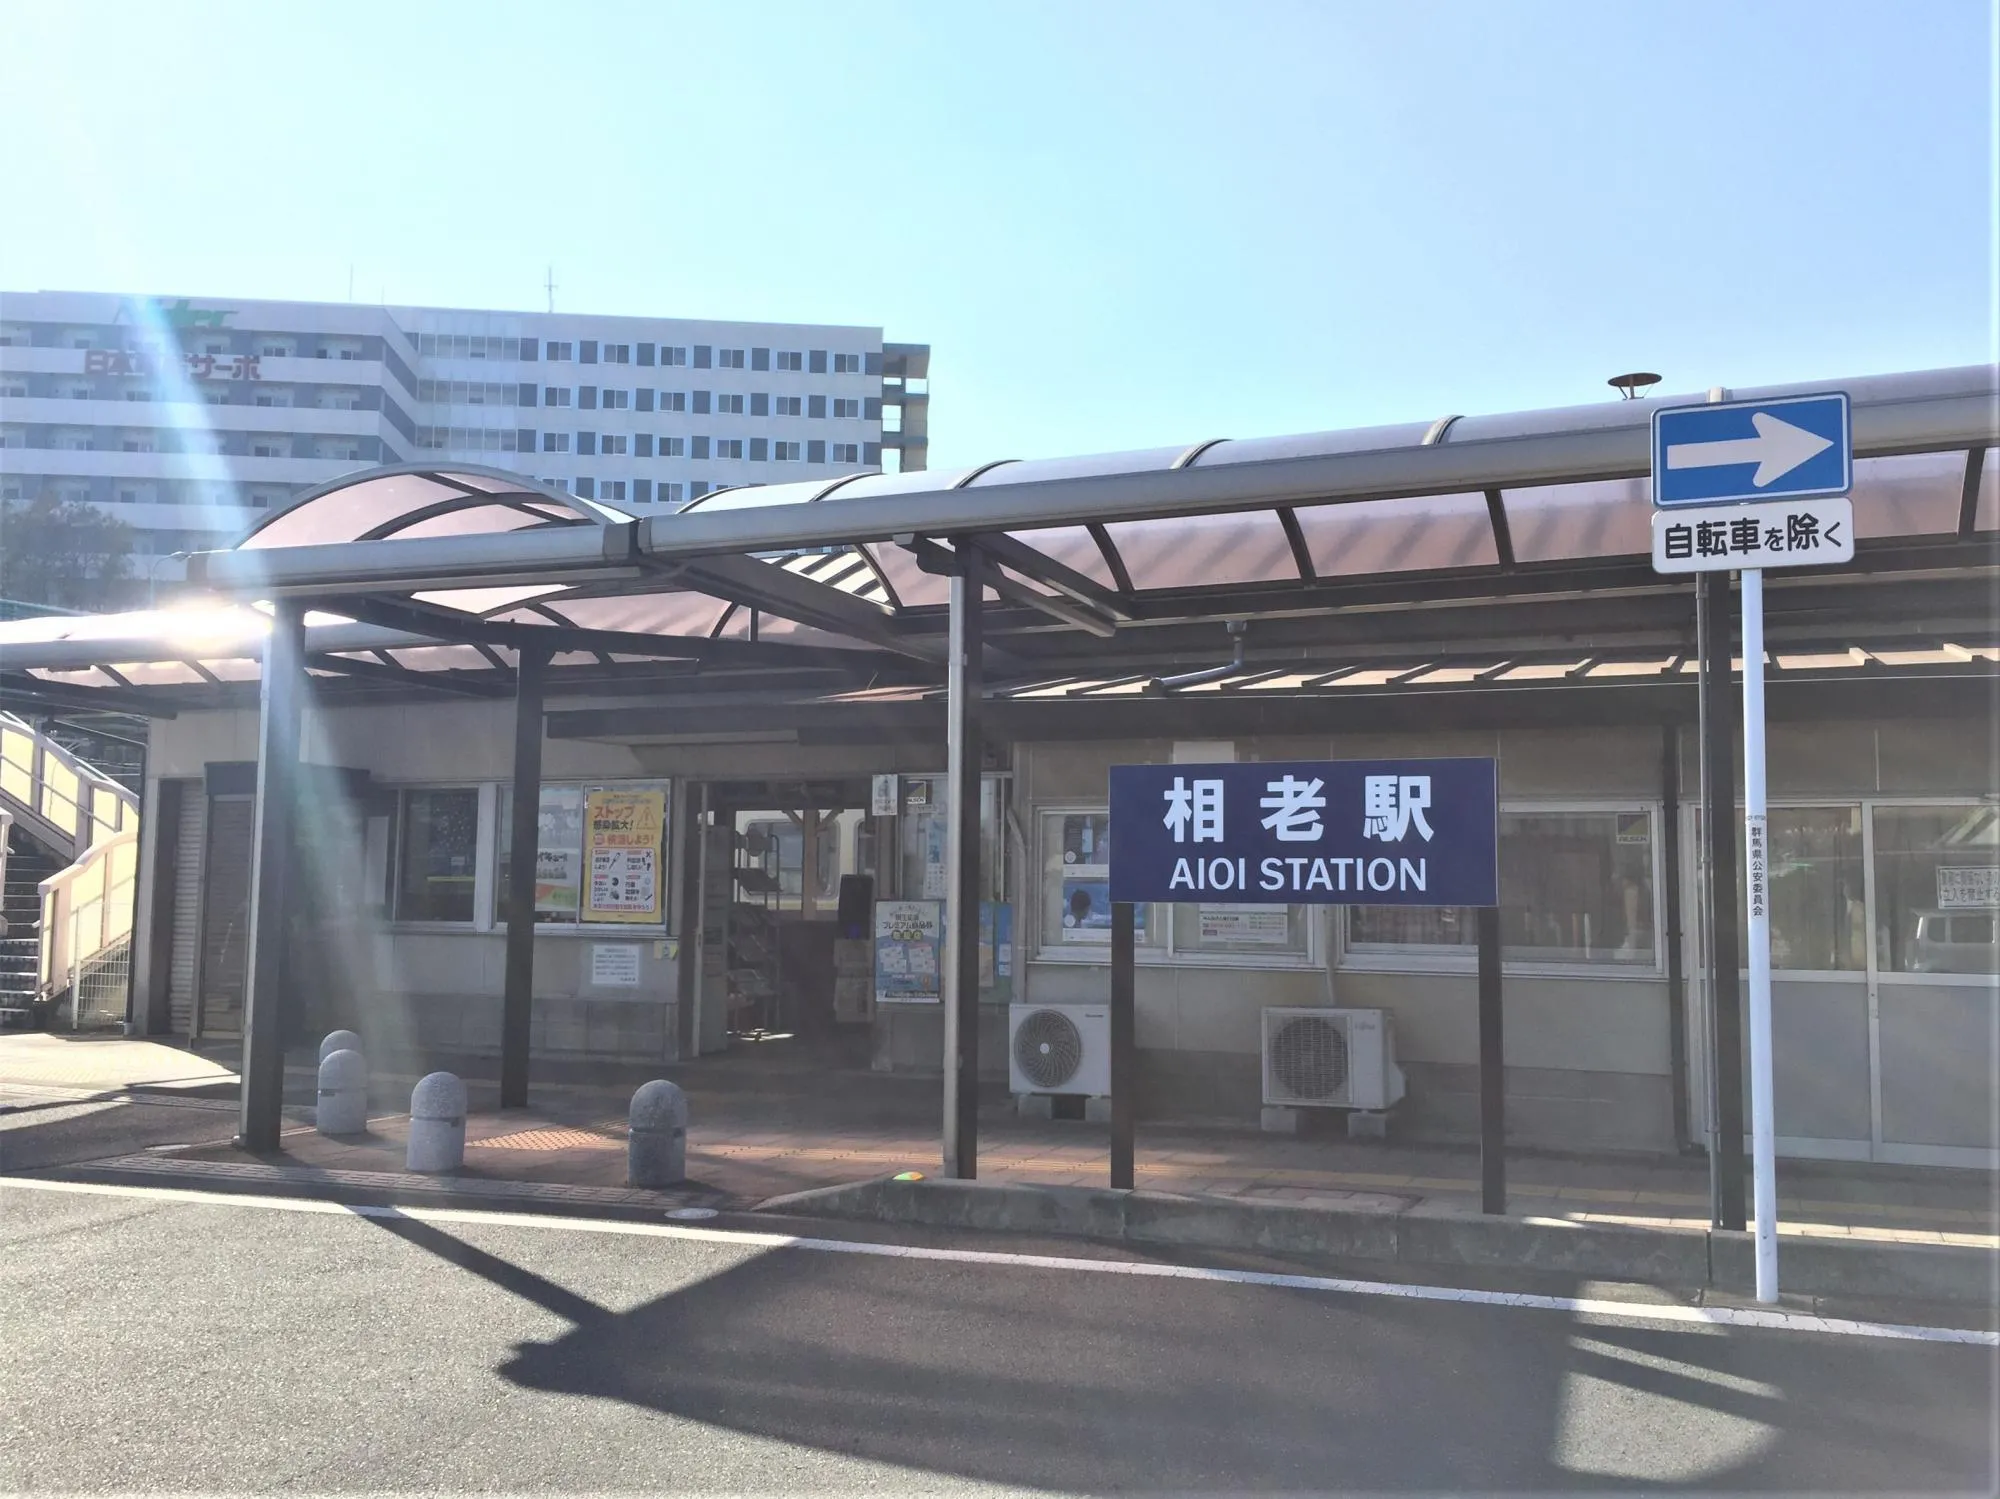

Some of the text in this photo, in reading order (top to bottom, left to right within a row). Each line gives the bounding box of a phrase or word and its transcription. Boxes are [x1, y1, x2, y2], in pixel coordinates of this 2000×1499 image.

[84, 349, 261, 380] 日本サーボ
[1665, 512, 1842, 559] 自転車を除く
[594, 805, 635, 819] ストップ
[1163, 774, 1434, 844] 相老駅
[1168, 857, 1427, 891] AIOI STATION
[1751, 827, 1764, 916] 群馬県公安委員会
